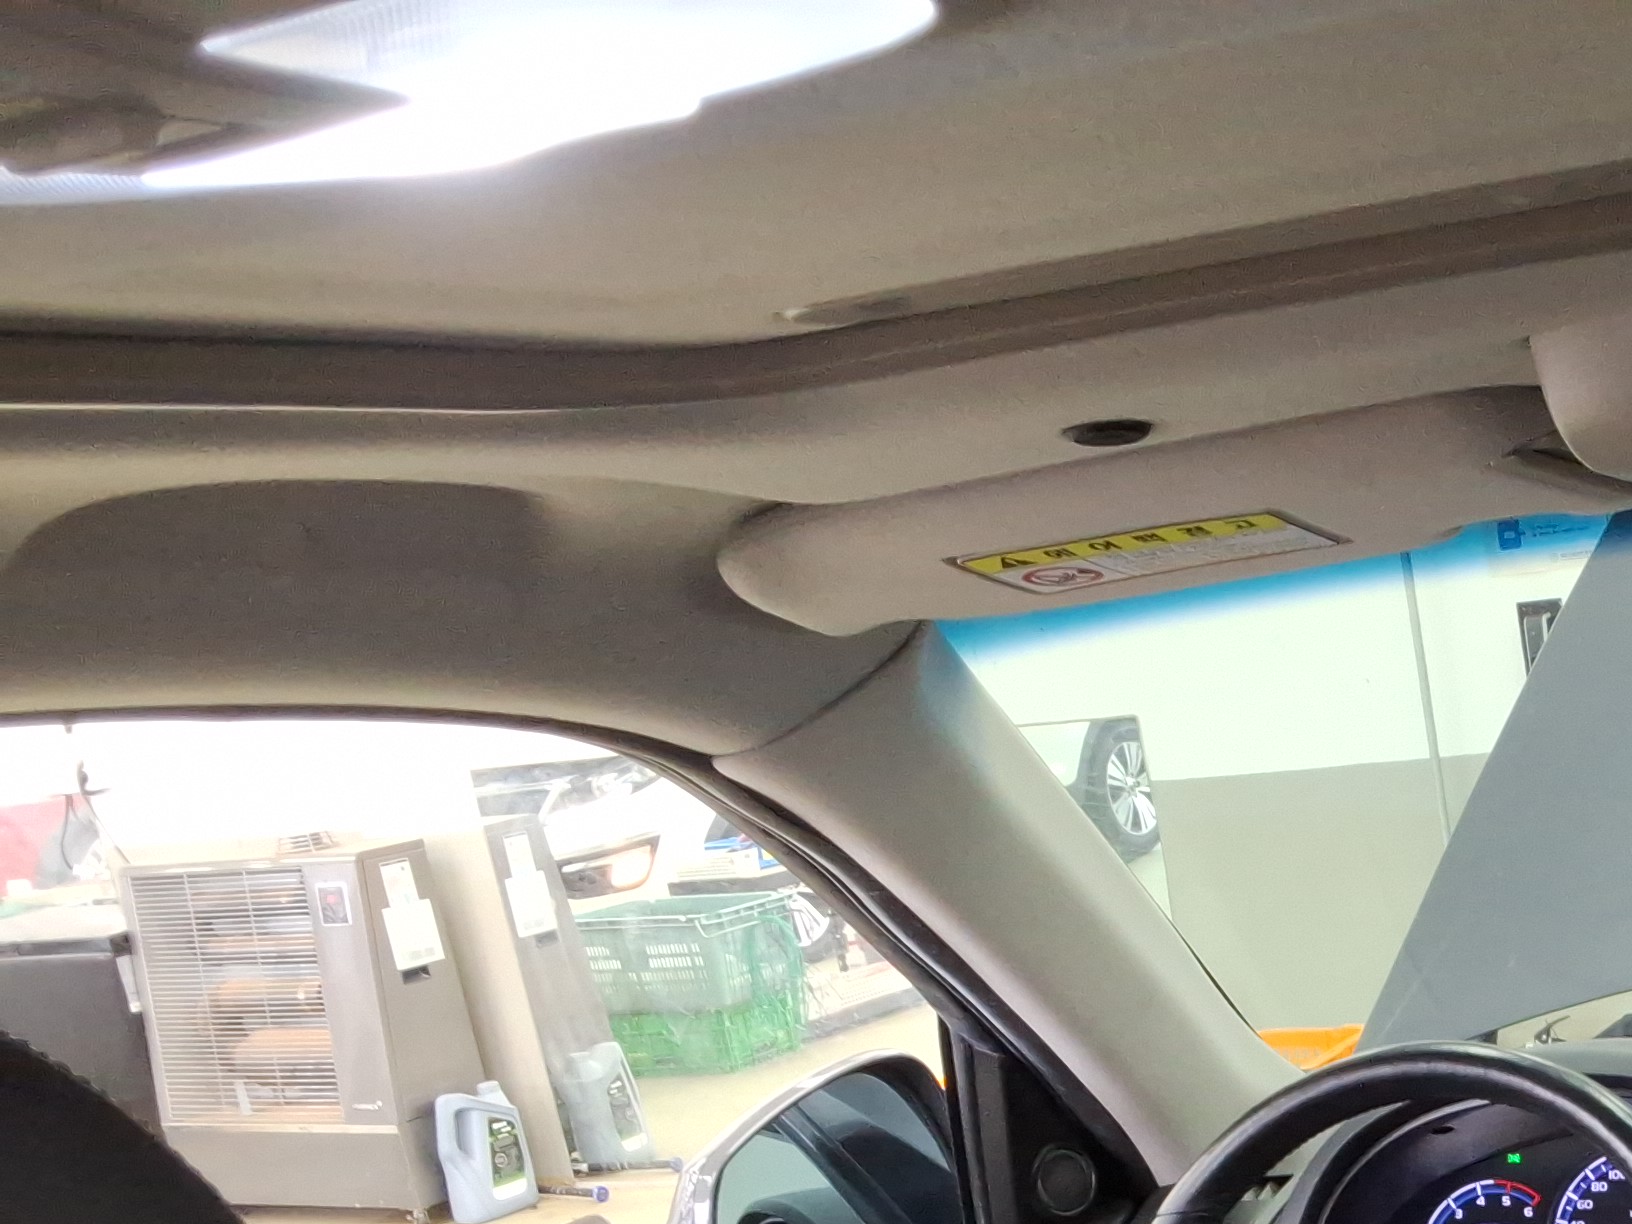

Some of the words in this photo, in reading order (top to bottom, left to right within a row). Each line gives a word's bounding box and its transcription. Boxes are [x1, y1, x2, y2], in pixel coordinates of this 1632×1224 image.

[1591, 1181, 1608, 1192] 80
[1476, 1196, 1486, 1206] 4
[1502, 1196, 1511, 1206] 5
[1577, 1200, 1593, 1210] 60
[1455, 1209, 1464, 1219] 3
[1524, 1207, 1533, 1217] 6
